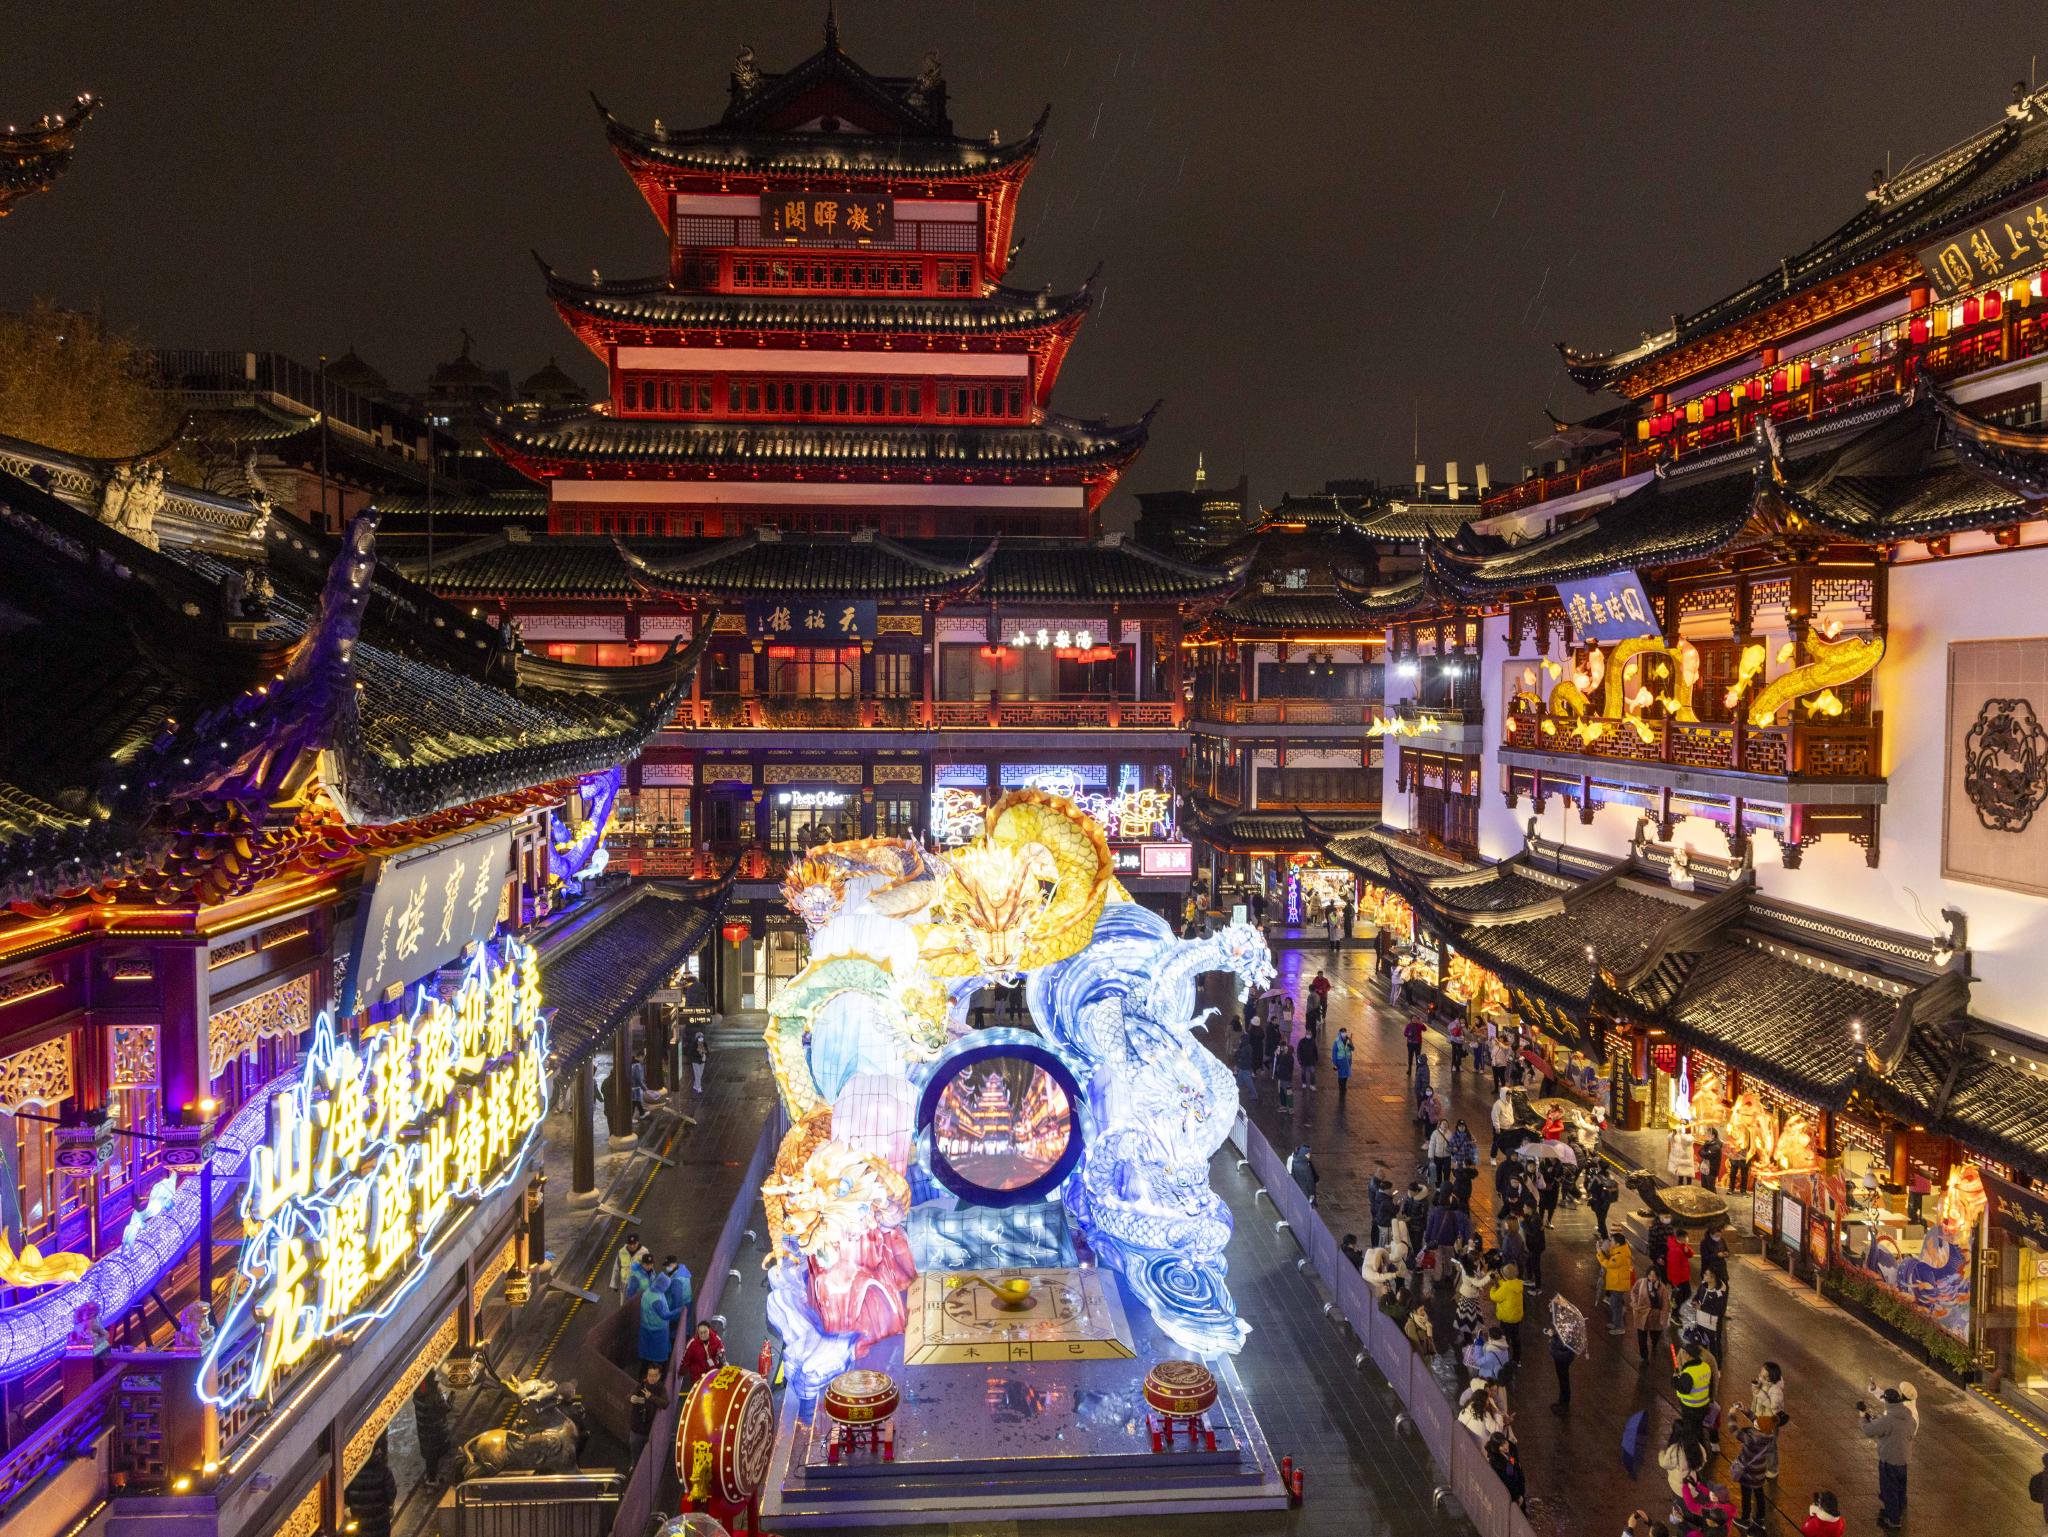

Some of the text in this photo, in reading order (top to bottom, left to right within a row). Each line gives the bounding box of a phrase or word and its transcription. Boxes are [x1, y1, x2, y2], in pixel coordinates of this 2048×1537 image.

[816, 791, 844, 806] Coffee
[260, 943, 542, 1218] 山海璀璨迎新春
[256, 1050, 541, 1399] 龙耀盛世铸辉煌
[1012, 1346, 1029, 1358] 午
